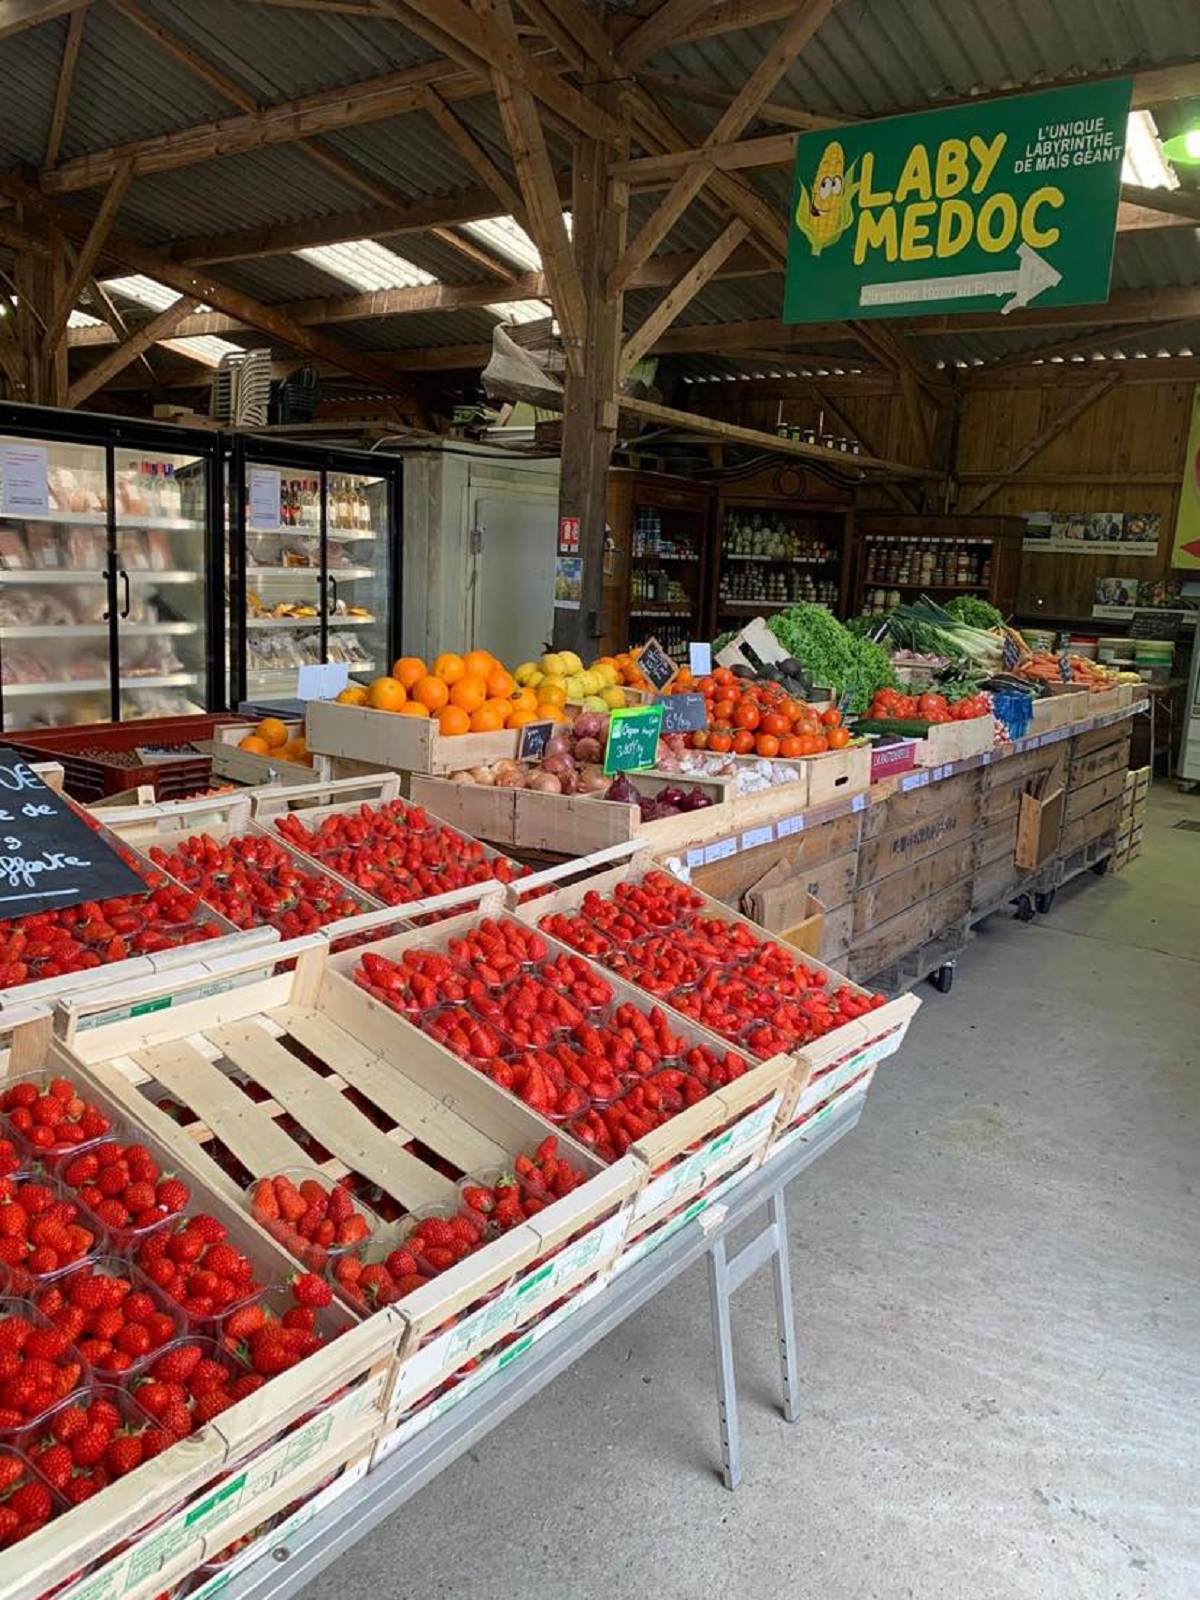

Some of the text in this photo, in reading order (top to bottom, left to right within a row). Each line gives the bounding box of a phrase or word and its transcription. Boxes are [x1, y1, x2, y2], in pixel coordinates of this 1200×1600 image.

[1037, 117, 1104, 141] L'UNIQUE
[1025, 132, 1114, 158] LABYRINTHE
[859, 132, 1007, 208] LABY
[1014, 159, 1033, 174] DE
[853, 187, 1065, 265] MEDOC
